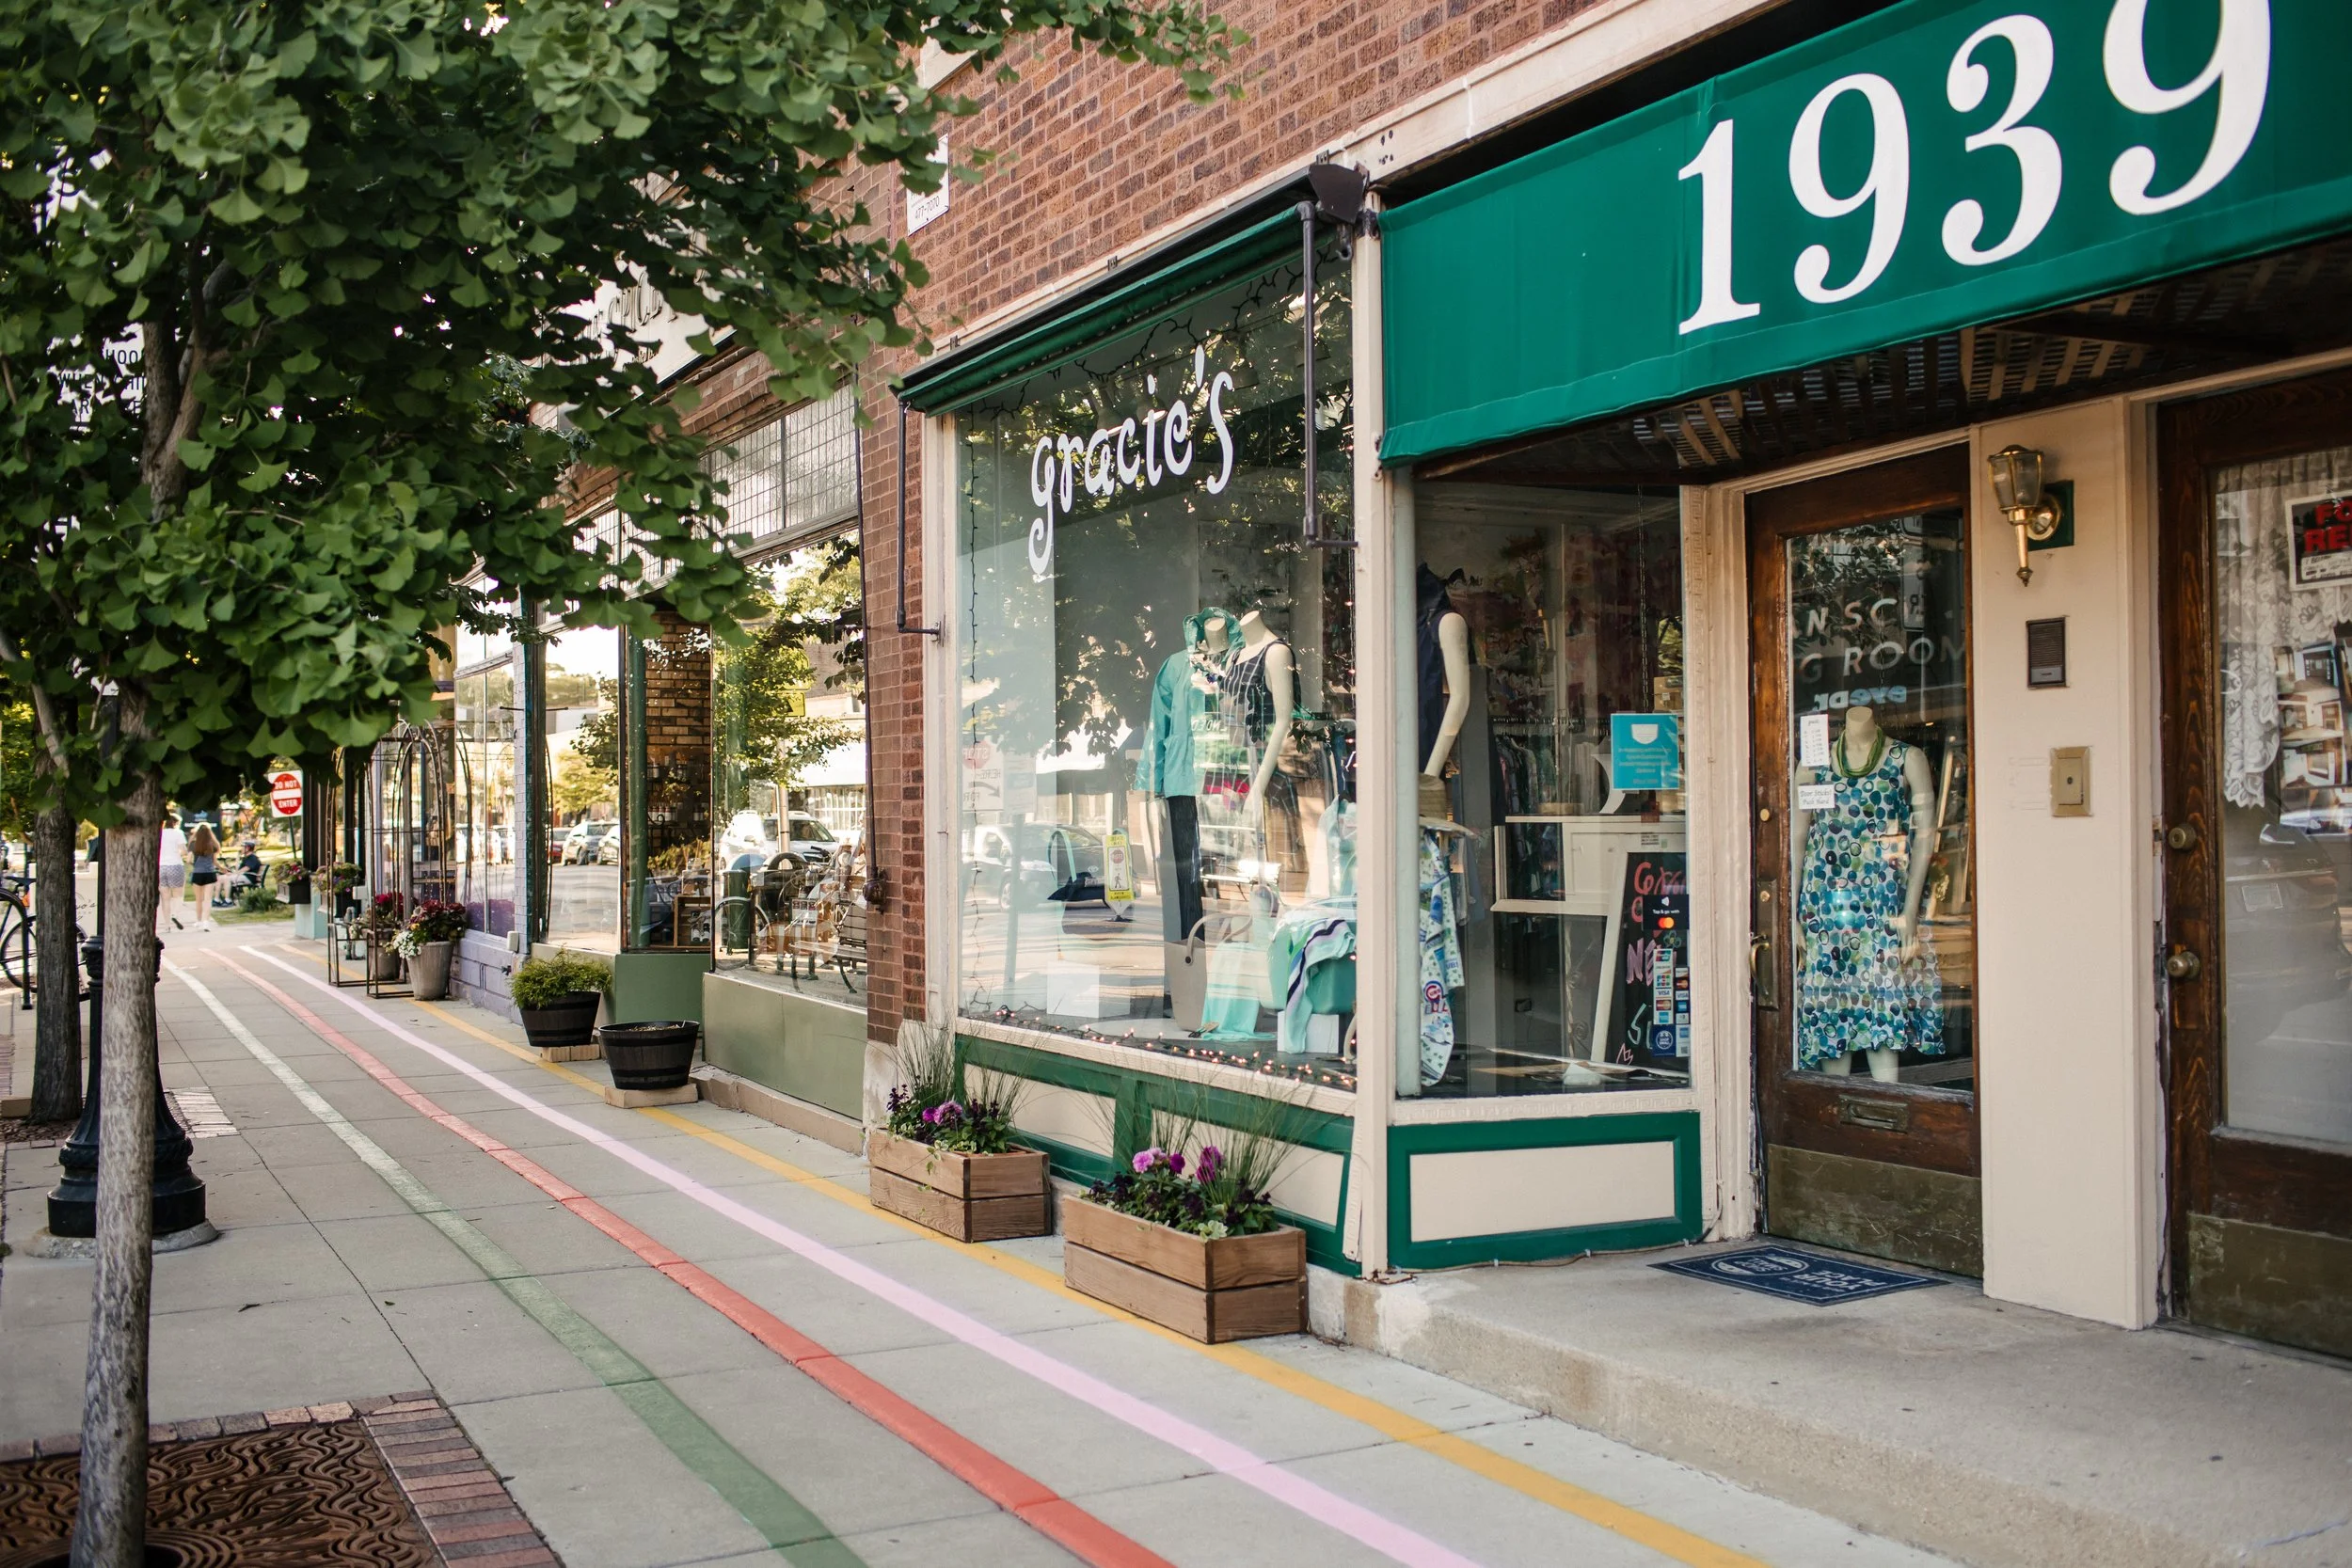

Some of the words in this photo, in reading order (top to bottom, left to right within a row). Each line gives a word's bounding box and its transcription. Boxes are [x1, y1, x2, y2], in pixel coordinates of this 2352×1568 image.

[1678, 0, 2272, 335] 1939
[1028, 345, 1233, 574] gracie's
[284, 779, 297, 788] NOT
[278, 798, 298, 809] ENTER
[1794, 1274, 1861, 1291] YOUR
[1812, 1270, 1887, 1287] PLACE
